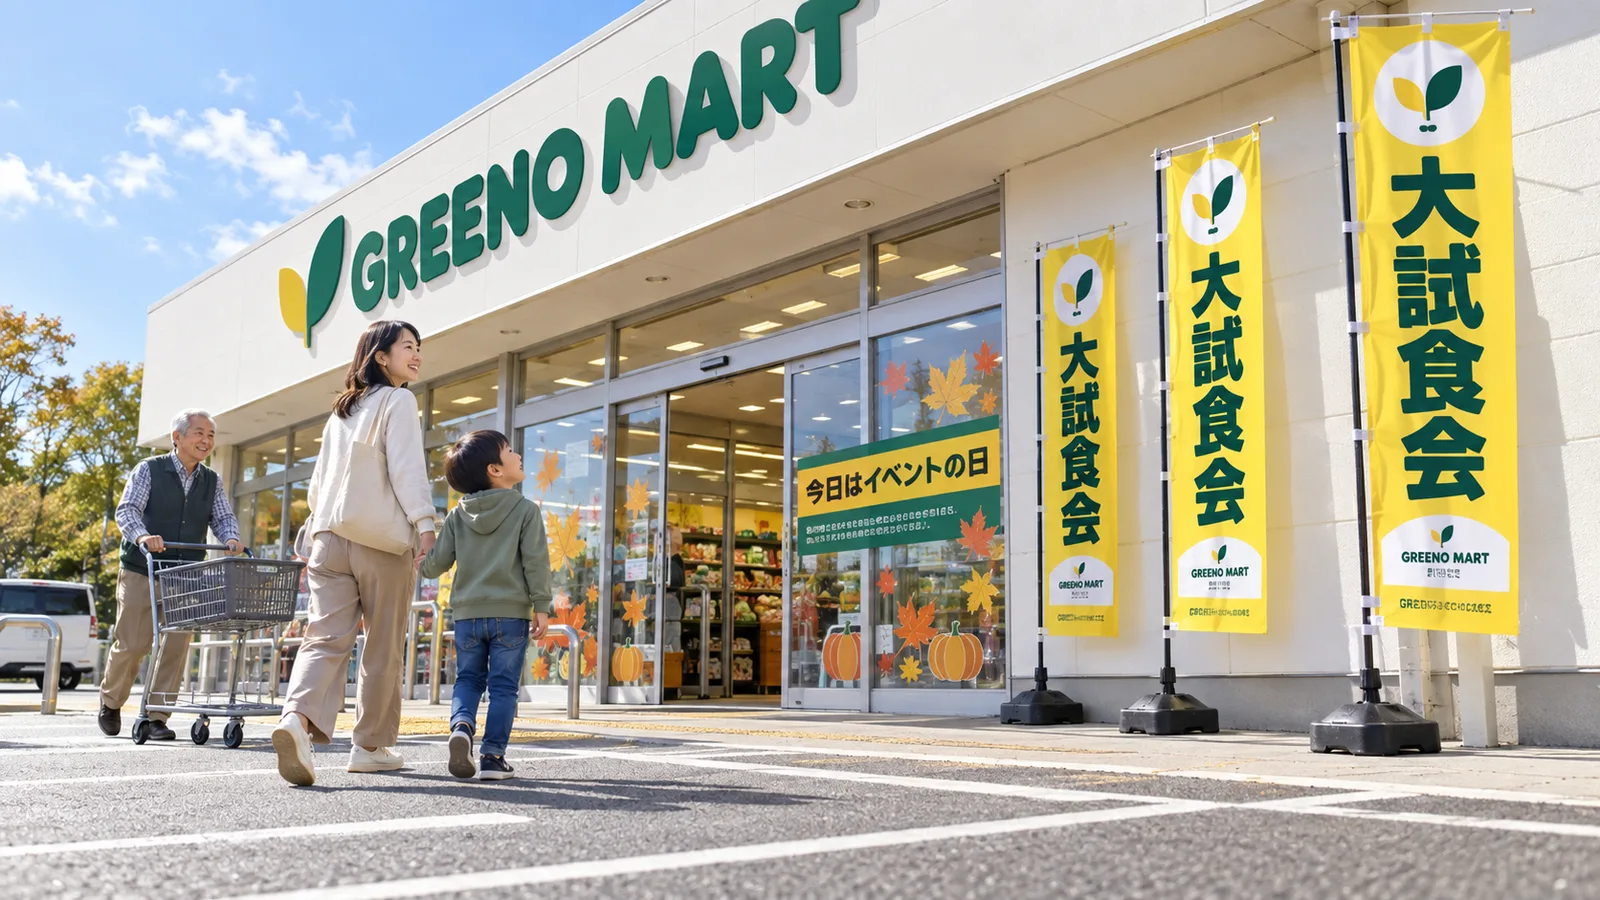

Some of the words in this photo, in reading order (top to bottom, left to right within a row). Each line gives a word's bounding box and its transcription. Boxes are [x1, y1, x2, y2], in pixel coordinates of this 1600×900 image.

[351, 127, 585, 313] GREENO
[601, 0, 861, 195] MART
[1191, 251, 1246, 527] 大試食会
[1390, 155, 1487, 502] 大試食会
[805, 446, 989, 505] 今日はイベントの日
[1060, 331, 1101, 547] 大試食会
[1084, 579, 1104, 588] MART
[1191, 567, 1224, 578] GREENO
[1225, 566, 1249, 577] MART
[1401, 551, 1450, 563] GREENO
[1453, 552, 1490, 564] MART
